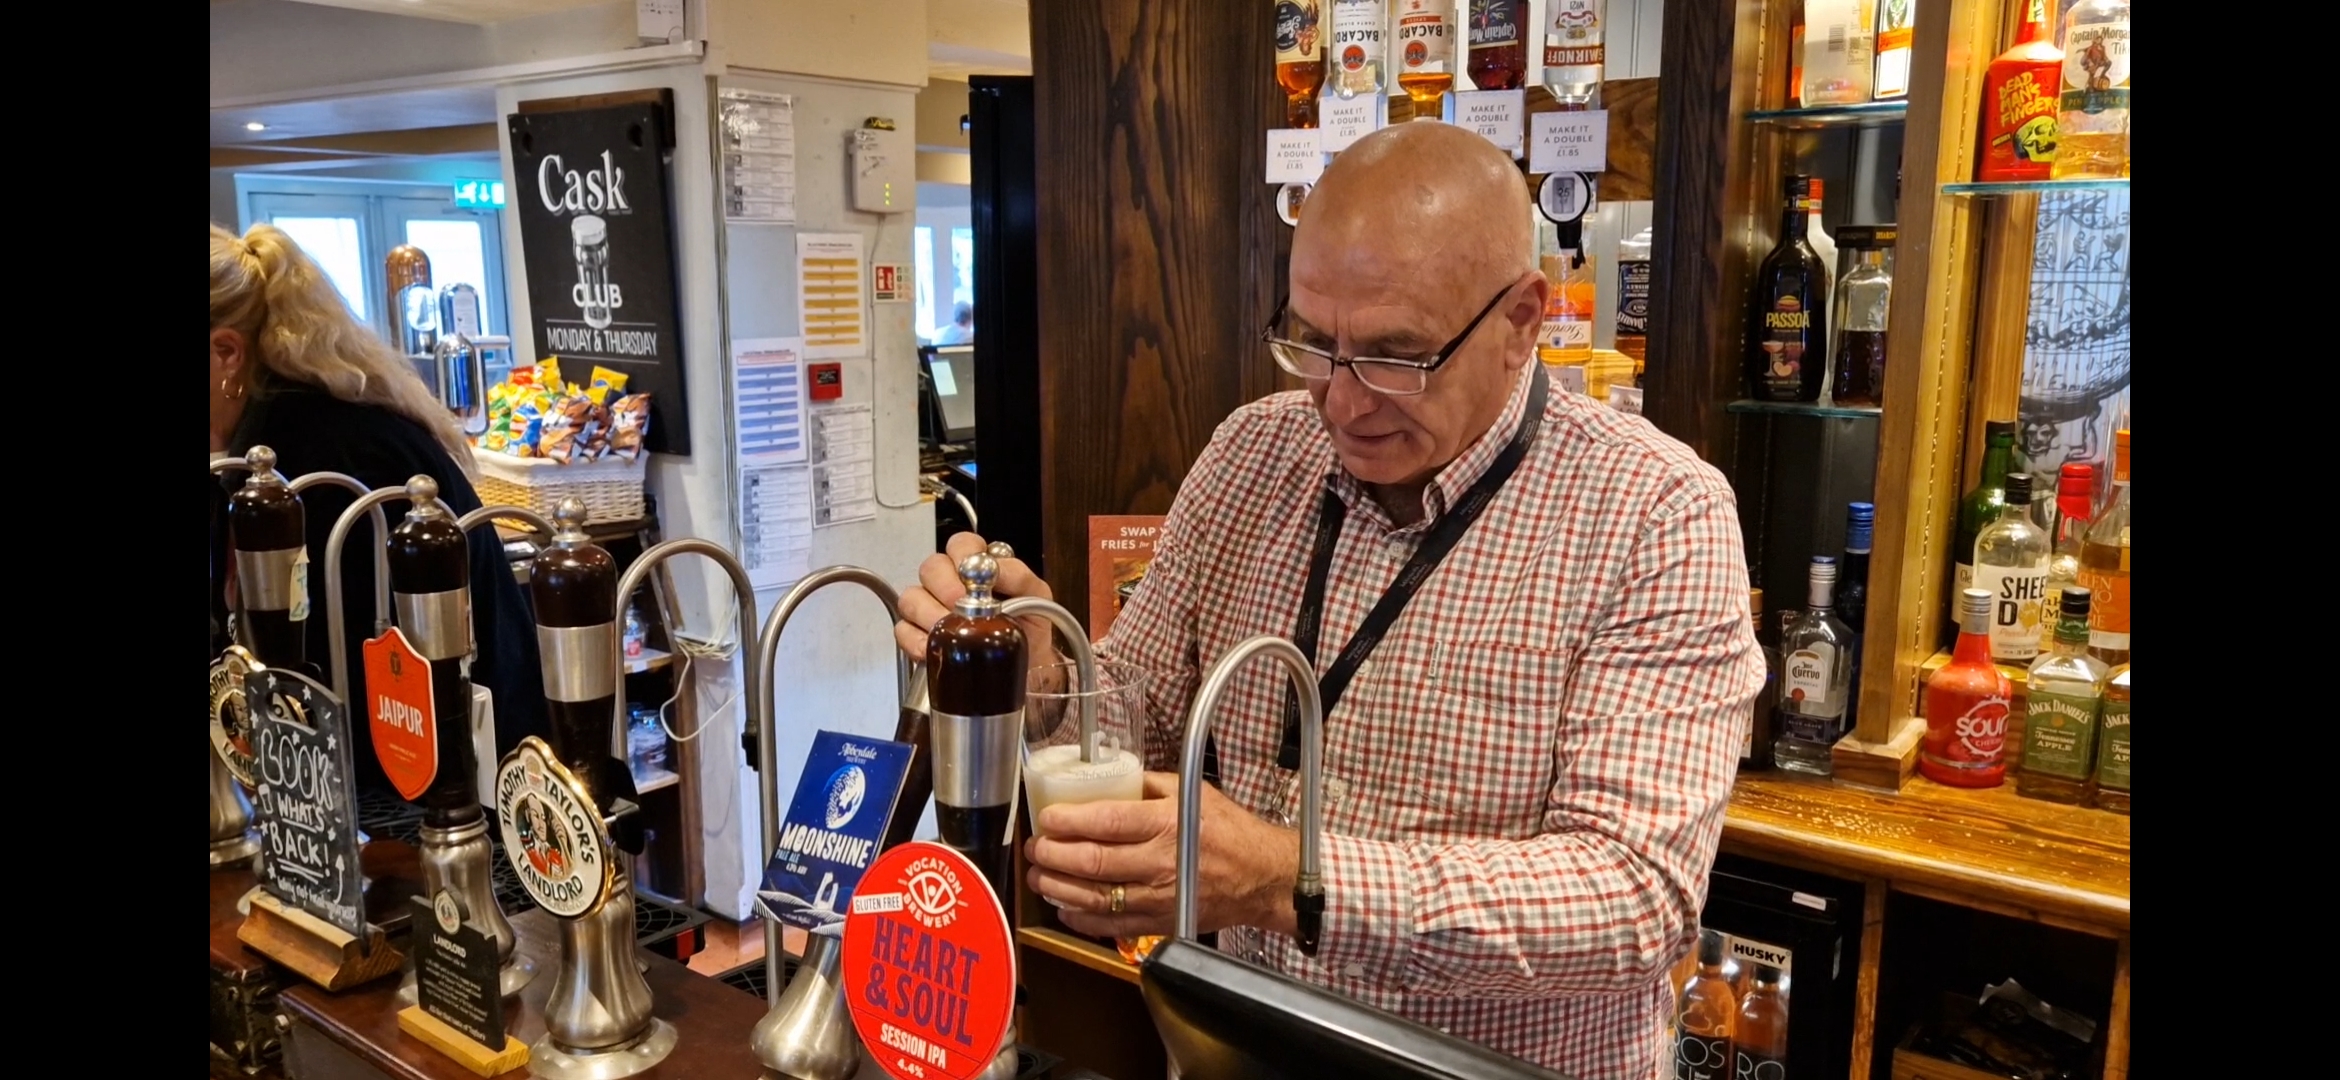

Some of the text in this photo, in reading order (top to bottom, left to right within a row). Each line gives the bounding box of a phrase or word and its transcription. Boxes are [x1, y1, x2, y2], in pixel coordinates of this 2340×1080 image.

[1484, 23, 1517, 41] Captain
[2070, 29, 2099, 45] Captain
[1547, 48, 1603, 64] SMIRNOFF
[1999, 71, 2033, 100] DEAD
[2001, 83, 2041, 113] MAN'S
[1337, 116, 1366, 124] DOUBLE
[1474, 114, 1510, 122] DOUBLE
[1550, 125, 1589, 134] MAKE IT
[1553, 135, 1594, 143] DOUBLE
[1557, 149, 1579, 157] £1.85
[538, 149, 630, 213] Cask
[572, 283, 623, 309] CLUB
[547, 327, 658, 357] MONDAY & THURSDAY
[1120, 526, 1157, 537] SWAP
[1101, 540, 1136, 550] FRIES
[1138, 541, 1150, 549] for
[1792, 665, 1820, 679] Cuervo
[377, 694, 424, 738] JAIPUR
[2028, 699, 2091, 725] JACK DANIEL'S
[2037, 740, 2073, 752] APPLE
[261, 728, 334, 812] LOOK
[277, 792, 325, 833] WHAT'S
[503, 765, 595, 865] TIMOTHY TAYLOR'S
[775, 850, 800, 864] PALE ALE
[779, 822, 873, 869] MOONSHINE
[517, 852, 584, 902] LANDLORD
[905, 857, 963, 895] VOCATION
[855, 895, 900, 912] GLUTEN FREE
[903, 892, 957, 928] BREWERY
[433, 933, 467, 958] LANDLORD
[872, 914, 980, 996] HEART
[1734, 943, 1786, 965] HUSKY
[865, 963, 973, 1047] & SOUL
[880, 1022, 947, 1069] SESSION IPA
[897, 1058, 924, 1079] 4.4%
